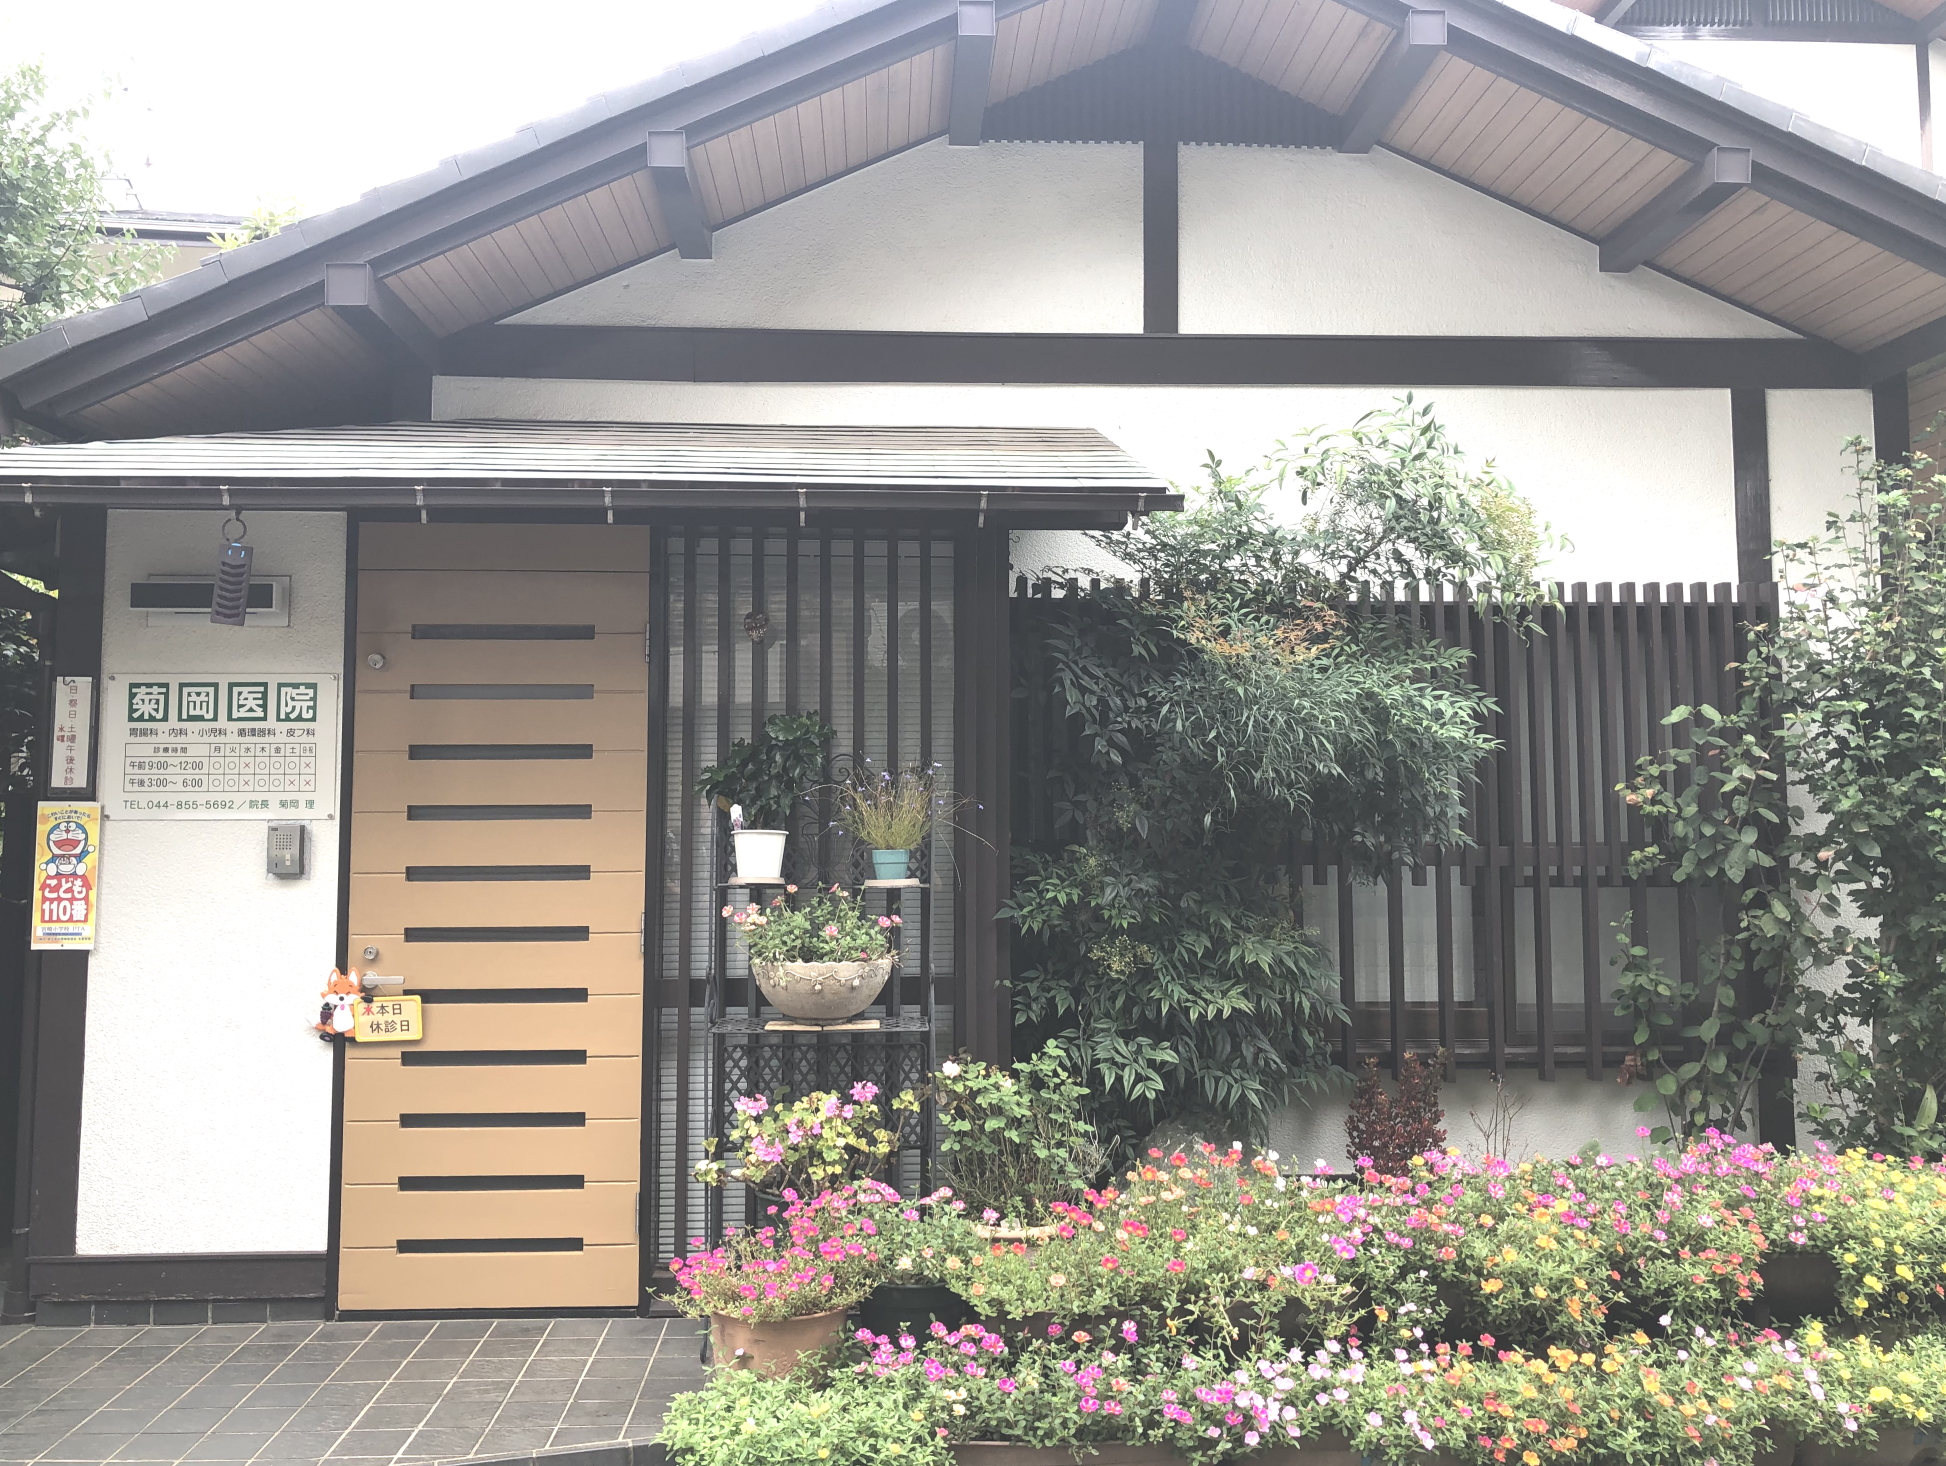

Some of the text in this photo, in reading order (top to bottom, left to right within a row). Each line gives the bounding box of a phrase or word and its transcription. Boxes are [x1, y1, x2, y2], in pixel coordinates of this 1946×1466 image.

[130, 684, 316, 720] 菊岡医院
[153, 746, 188, 754] 診療時間
[213, 746, 221, 754] 月
[229, 746, 237, 754] 火
[243, 746, 252, 754] 水
[258, 746, 267, 754] 木
[273, 746, 282, 754] 金
[289, 746, 297, 754] 土
[278, 799, 299, 810] 菊岡
[305, 799, 315, 810] 理
[44, 877, 87, 899] こども
[42, 899, 87, 922] 110番
[370, 1020, 410, 1034] 休診日
